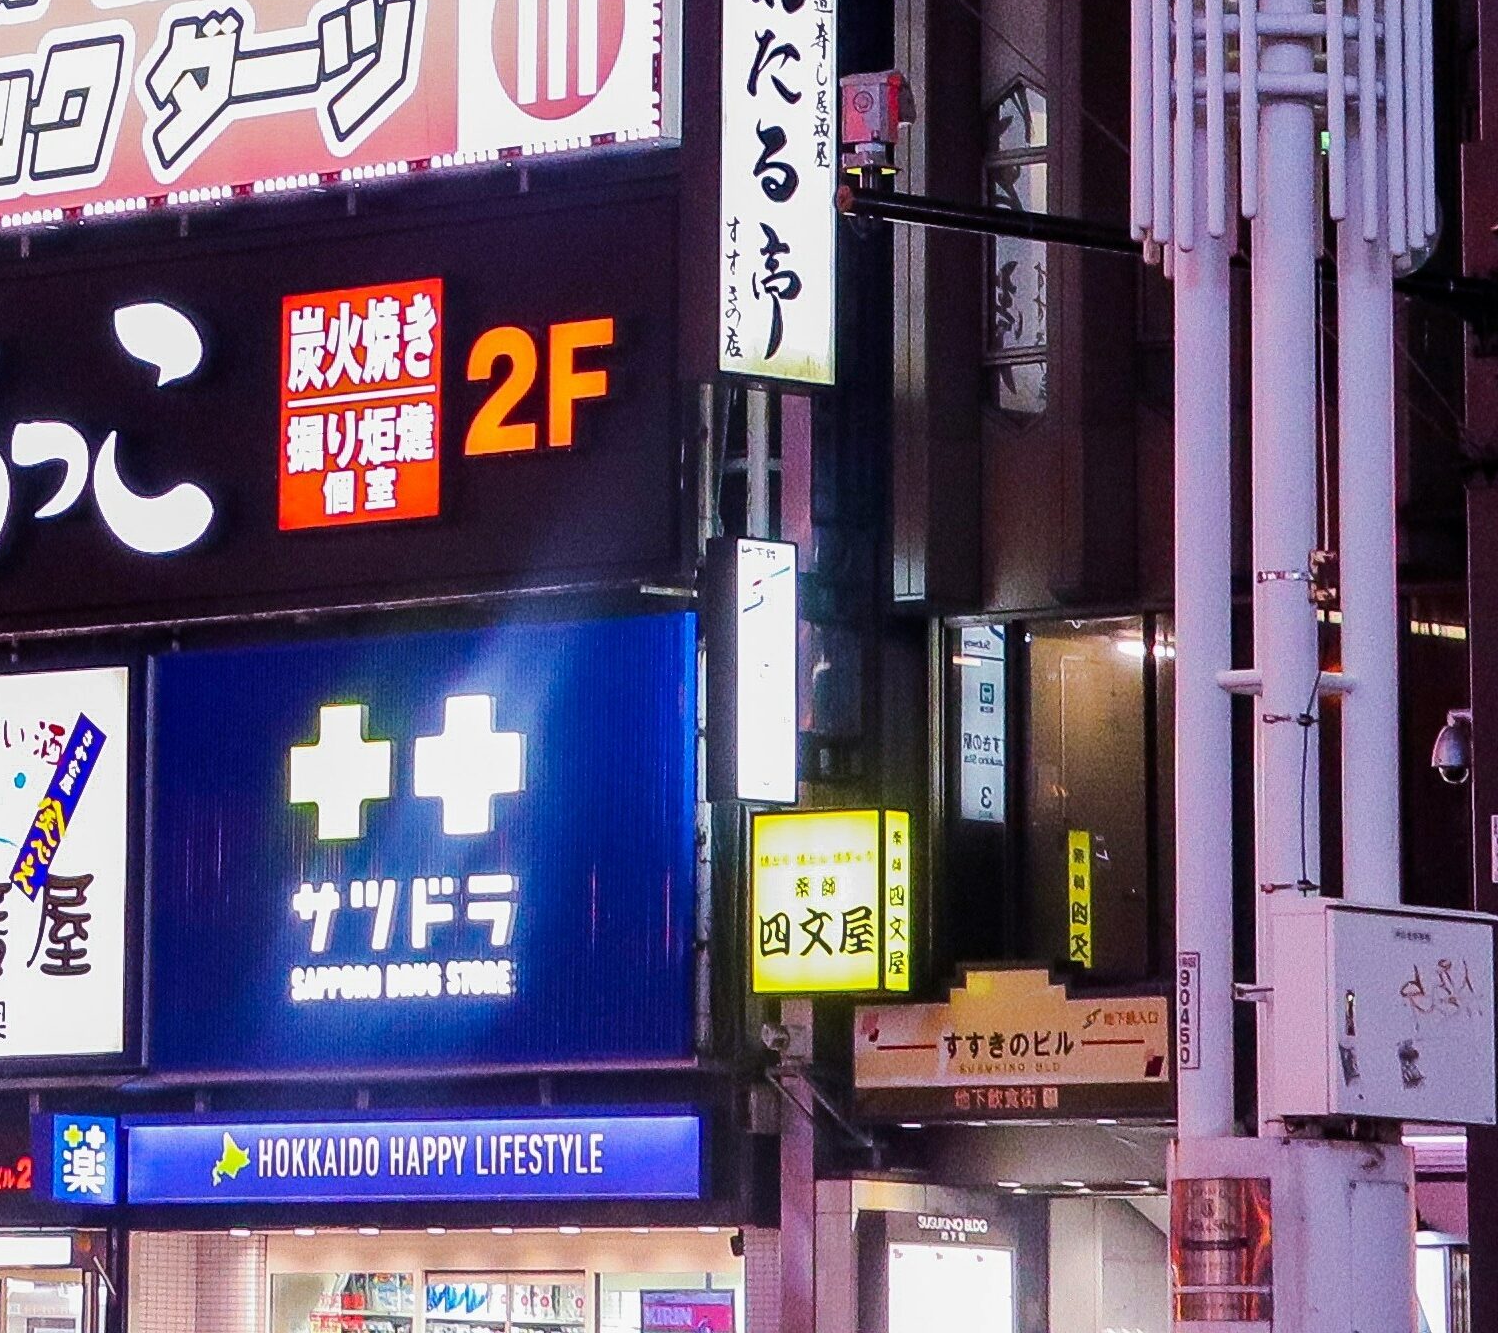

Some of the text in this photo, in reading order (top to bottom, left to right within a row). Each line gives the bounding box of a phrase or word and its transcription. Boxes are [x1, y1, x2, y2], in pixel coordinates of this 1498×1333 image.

[287, 292, 438, 394] 炭火焼き
[464, 317, 615, 457] 2F
[322, 465, 398, 517] 個室
[758, 905, 875, 959] 四文屋
[289, 959, 513, 1003] SAPPORO DRUG STORE
[942, 1030, 1075, 1059] すすきのビル
[256, 1131, 605, 1180] HOKKAIDO HAPPY LIFESTYLE
